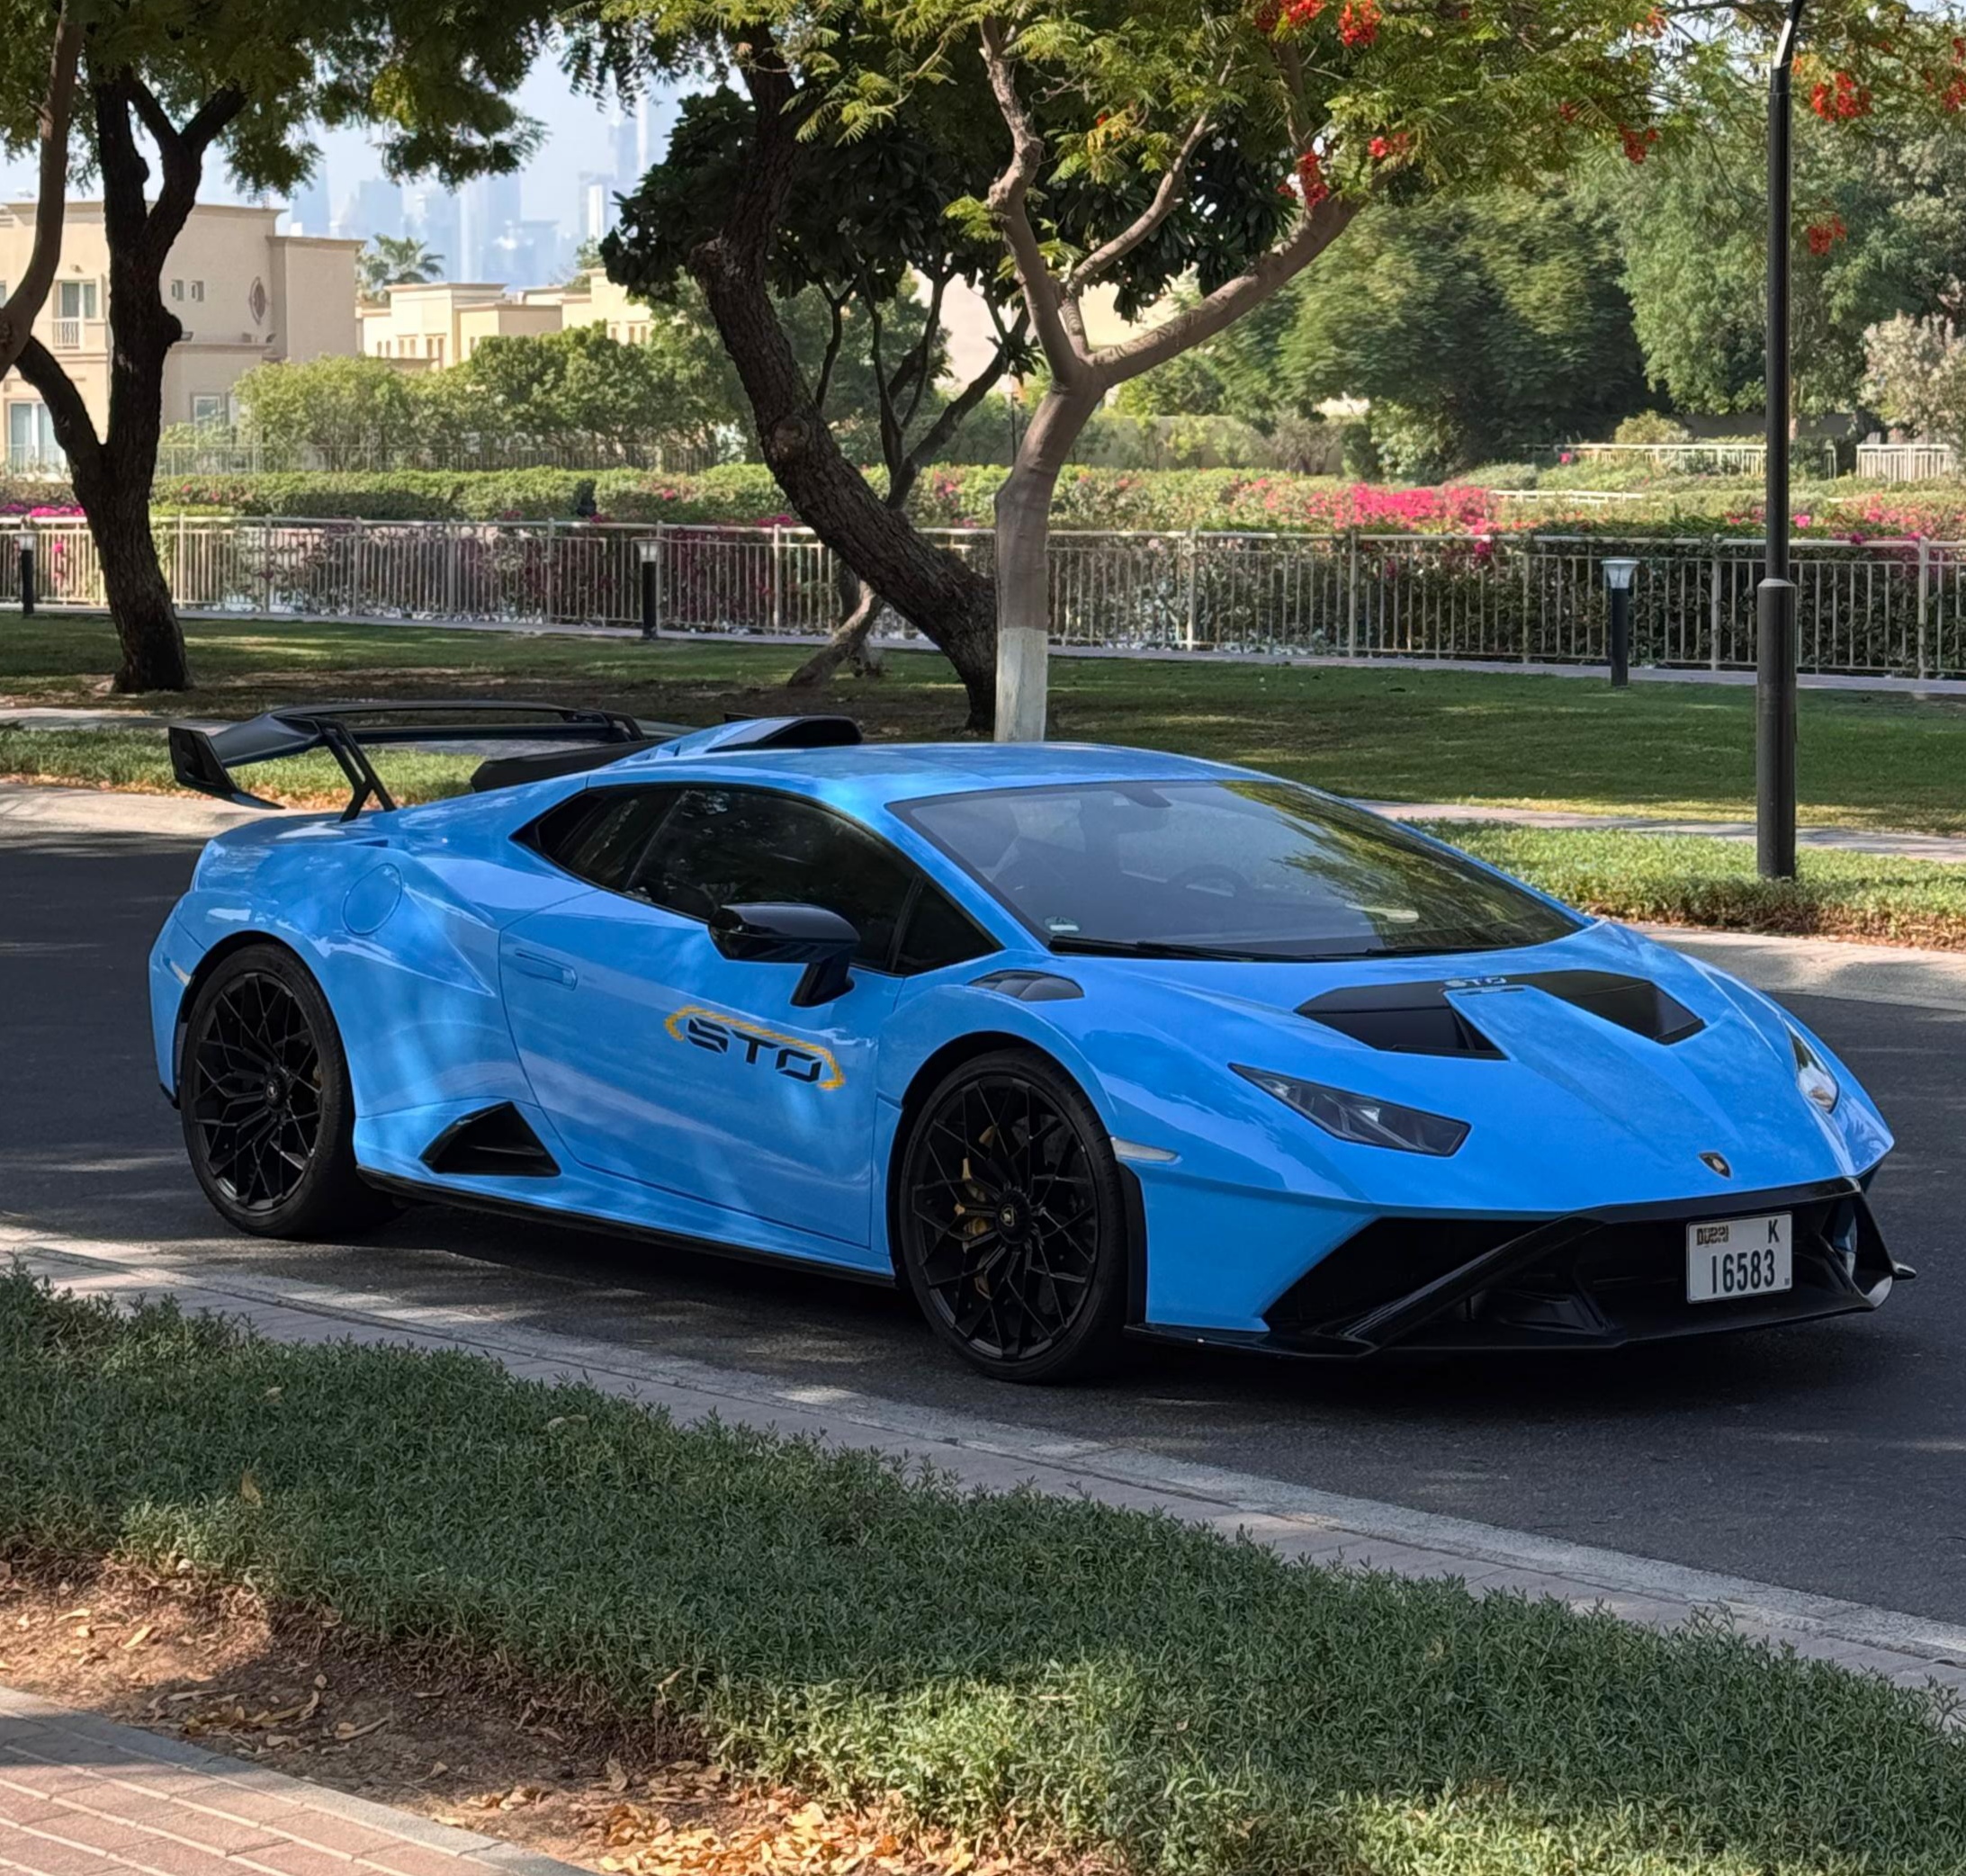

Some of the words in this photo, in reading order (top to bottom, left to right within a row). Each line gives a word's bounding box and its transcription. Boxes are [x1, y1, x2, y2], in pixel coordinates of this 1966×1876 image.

[687, 1016, 822, 1083] STO
[1768, 1218, 1780, 1243] K
[1711, 1249, 1775, 1294] 16583
